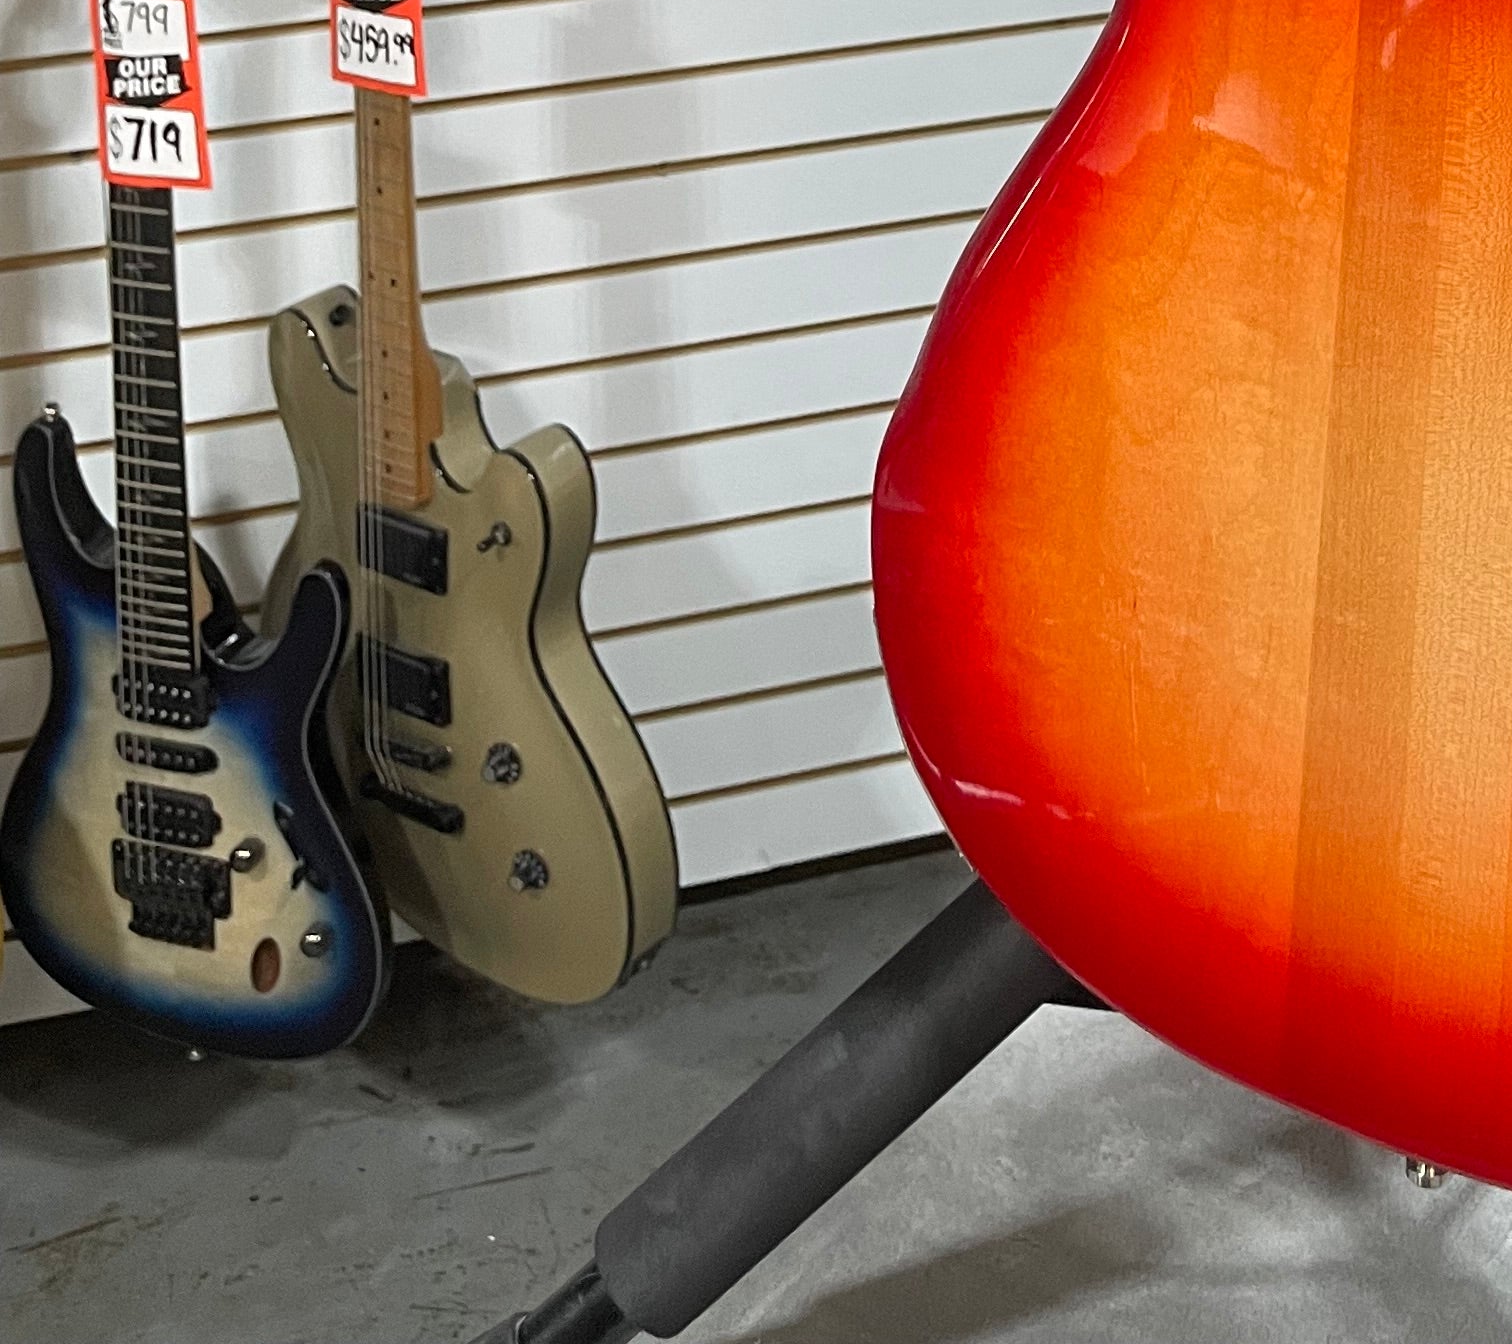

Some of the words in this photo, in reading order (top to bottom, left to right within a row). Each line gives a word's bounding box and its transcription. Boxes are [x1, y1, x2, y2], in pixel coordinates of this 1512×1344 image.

[118, 57, 168, 79] OUR
[113, 74, 182, 99] PRICE
[109, 114, 183, 163] $719
